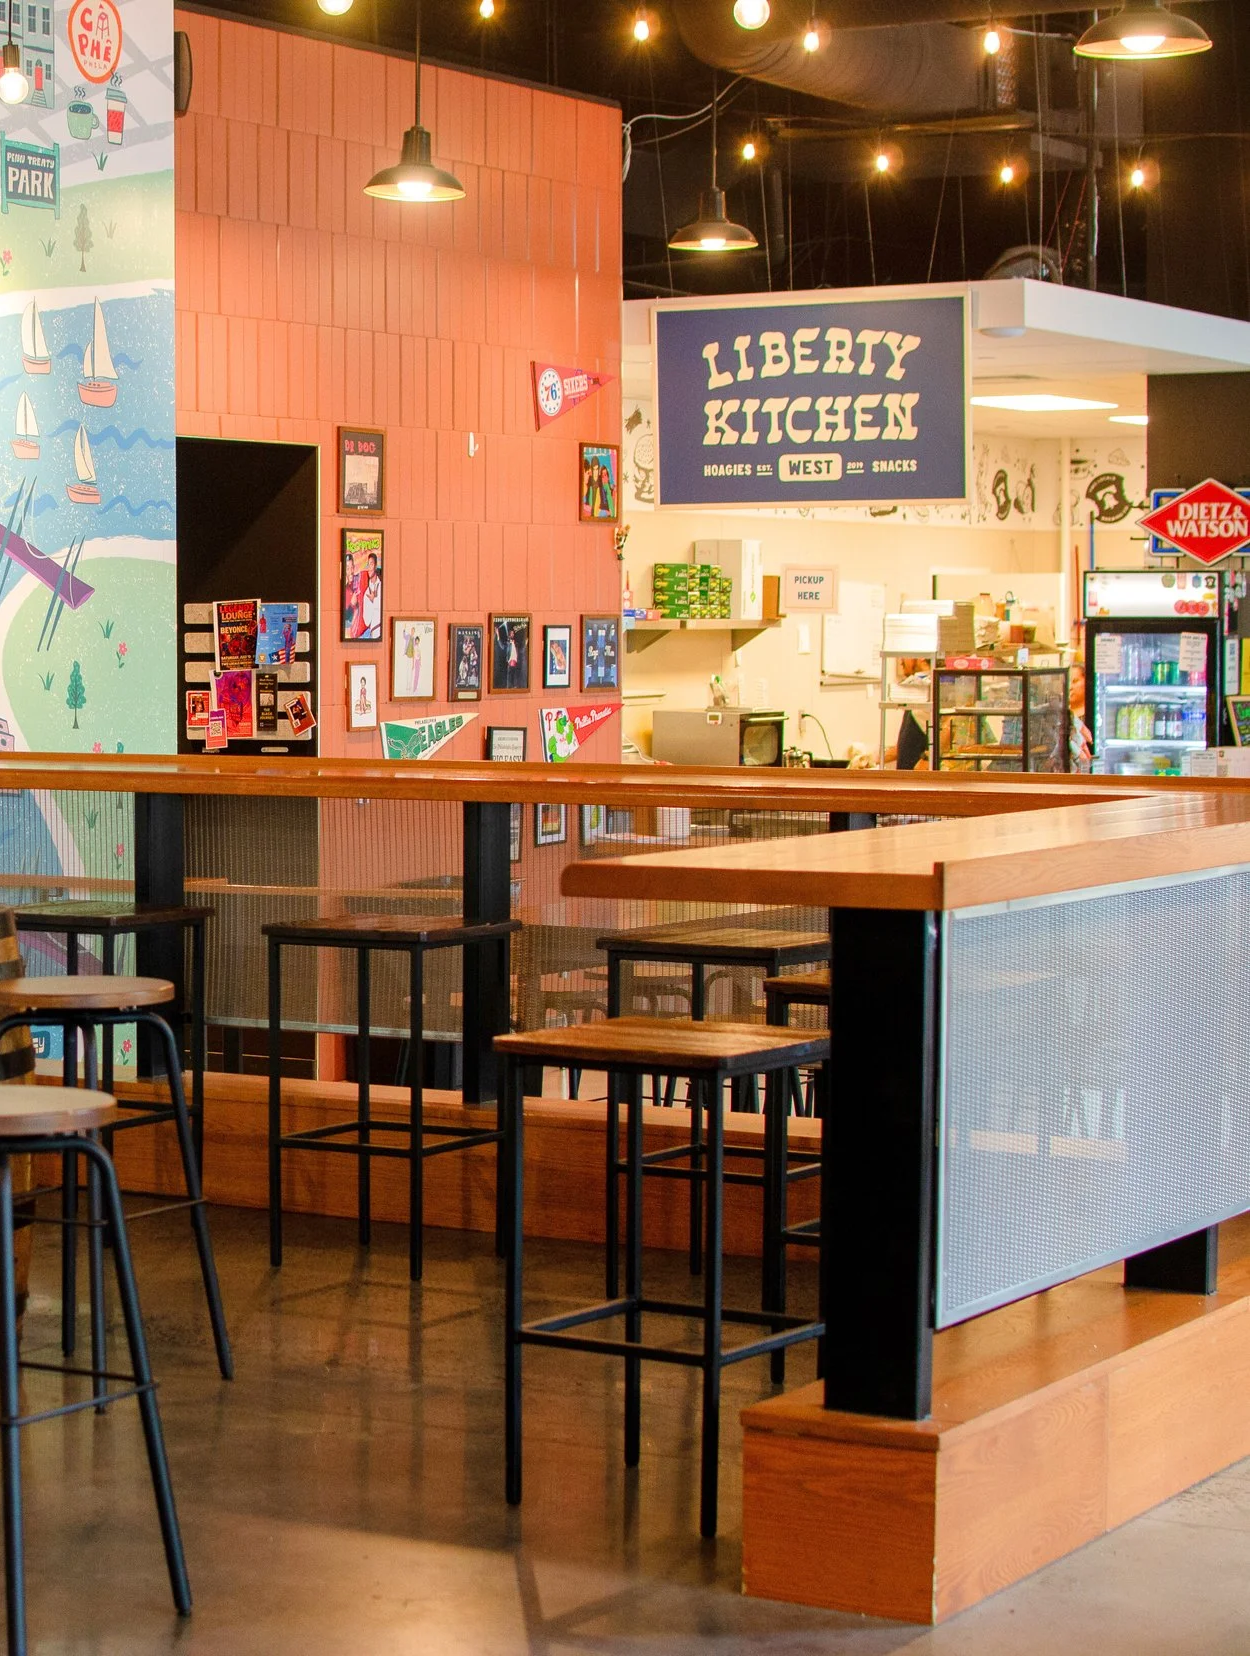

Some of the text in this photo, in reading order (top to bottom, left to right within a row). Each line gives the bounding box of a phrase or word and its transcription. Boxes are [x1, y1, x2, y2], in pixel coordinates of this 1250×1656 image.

[6, 152, 55, 169] PENN TREATY
[8, 166, 54, 199] PARK
[702, 327, 921, 390] LIBERTY
[544, 382, 557, 402] 76
[563, 374, 588, 396] SIXERS
[703, 393, 920, 445] KITCHEN
[704, 464, 752, 477] HOAGIES
[788, 460, 834, 476] WEST
[846, 462, 864, 470] 2019
[872, 459, 918, 473] SNACKS
[1179, 502, 1231, 520] DIETZ
[1166, 519, 1249, 538] WATSON
[794, 575, 824, 584] PICKUP
[798, 592, 820, 600] HERE
[221, 611, 253, 621] LOUNGE
[419, 715, 464, 753] EAGLES
